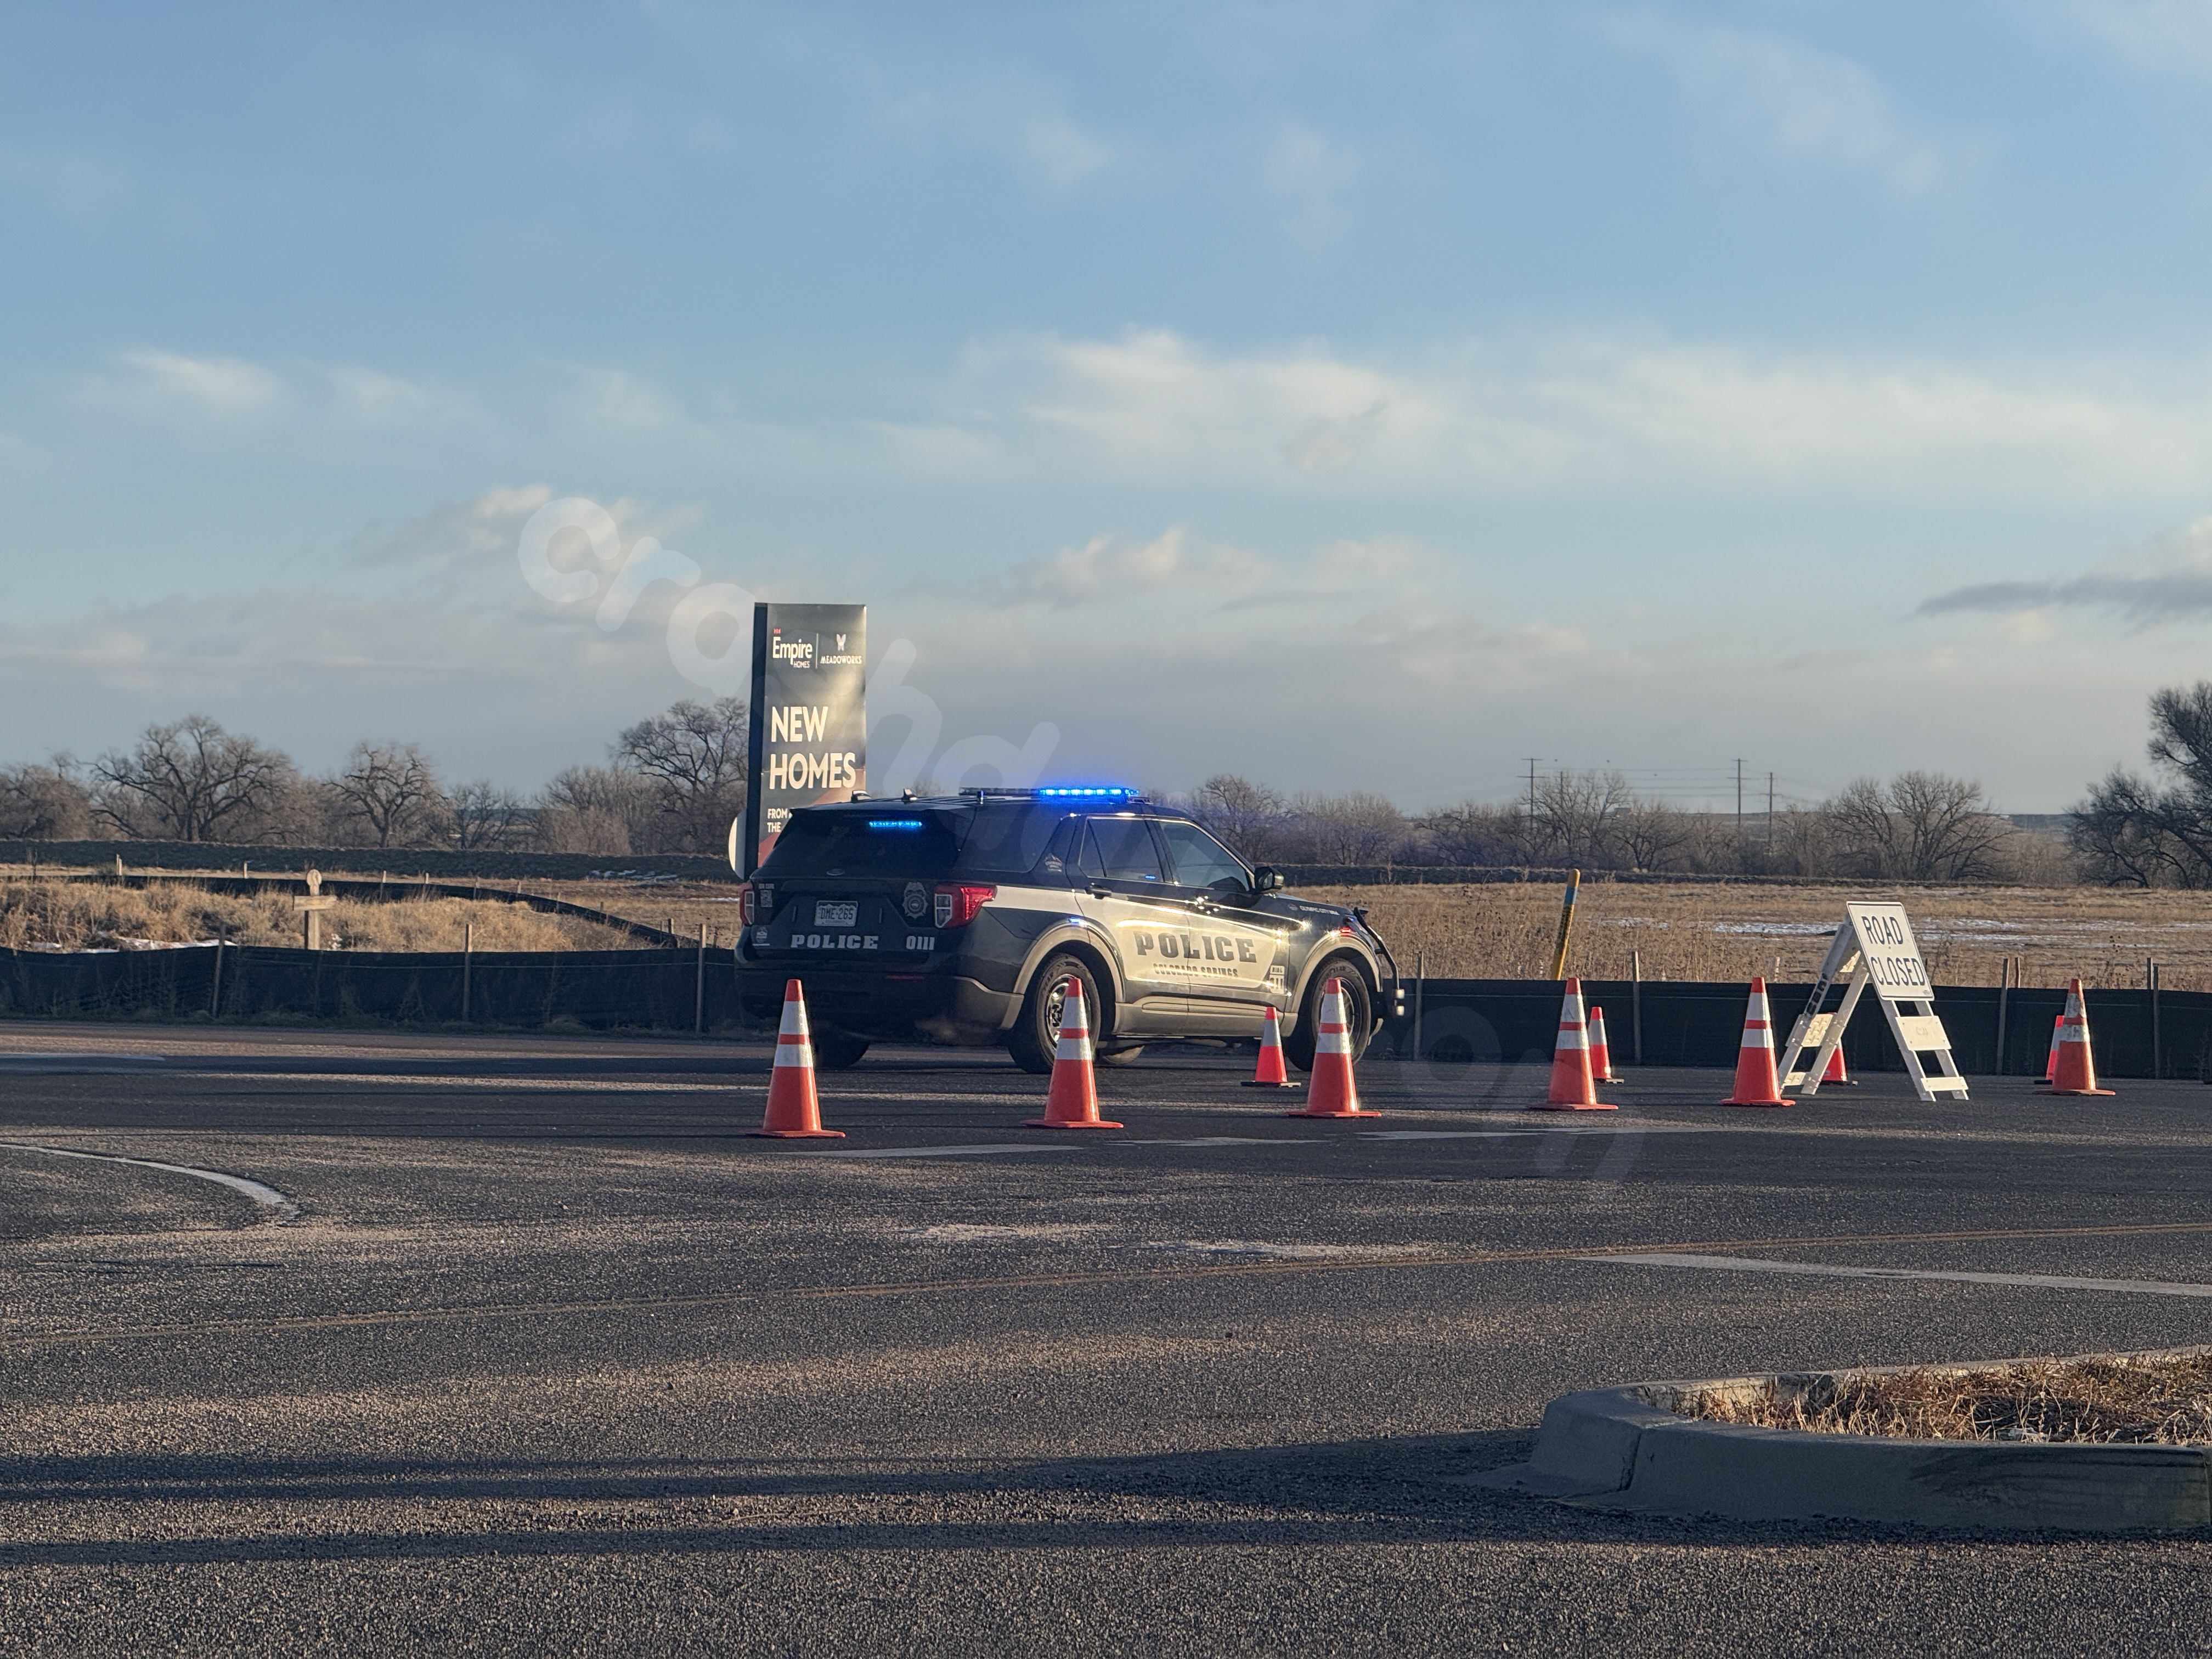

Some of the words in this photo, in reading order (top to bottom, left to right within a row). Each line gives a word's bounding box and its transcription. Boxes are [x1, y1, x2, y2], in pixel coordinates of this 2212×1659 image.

[772, 636, 812, 665] Empire
[820, 656, 862, 664] MEADOWORKS
[771, 706, 828, 742] NEW
[769, 752, 856, 789] HOMES
[767, 822, 781, 833] THE
[768, 808, 788, 819] FROM
[791, 934, 878, 950] POLICE
[1861, 916, 1904, 945] ROAD
[1135, 932, 1257, 963] POLICE
[1870, 956, 1926, 986] CLOSED
